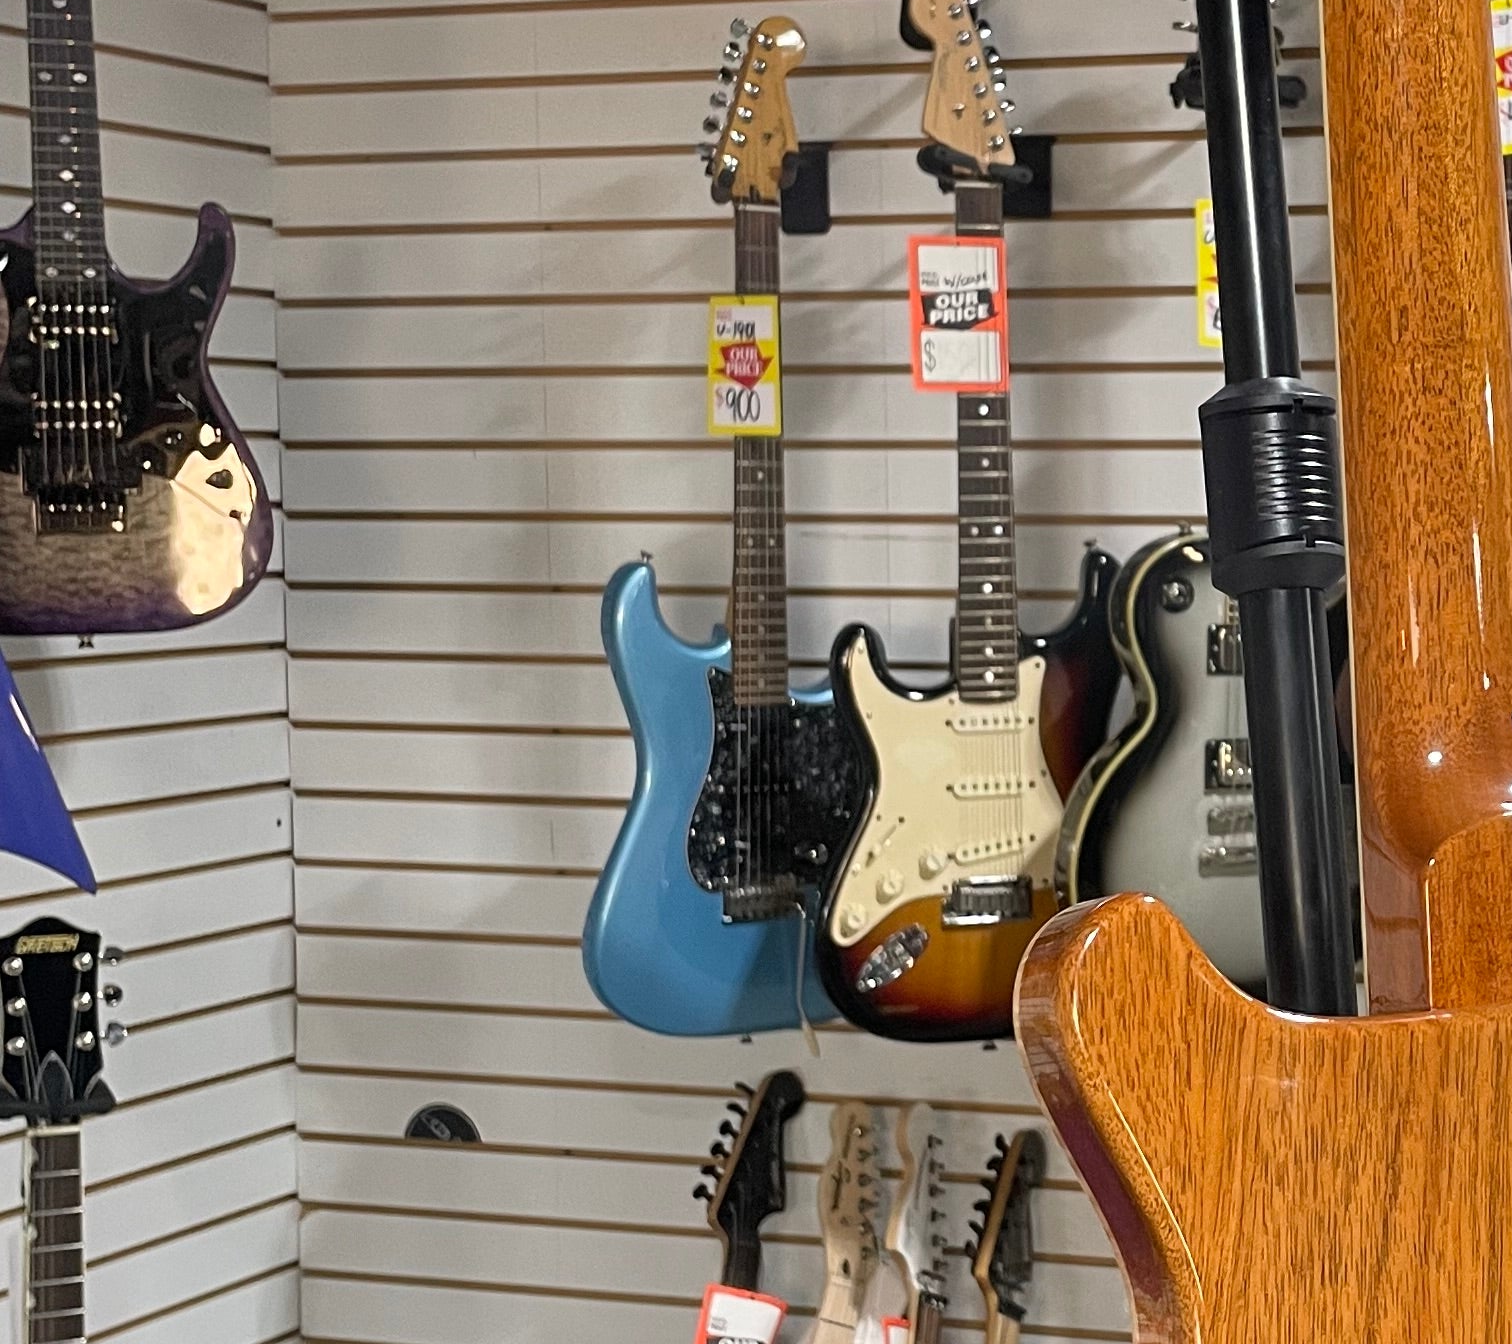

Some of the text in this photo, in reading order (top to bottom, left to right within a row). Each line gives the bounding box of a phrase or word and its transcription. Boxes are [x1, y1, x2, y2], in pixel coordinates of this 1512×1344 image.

[935, 290, 979, 309] OUR
[929, 303, 990, 325] PRICE
[730, 345, 758, 361] OUR
